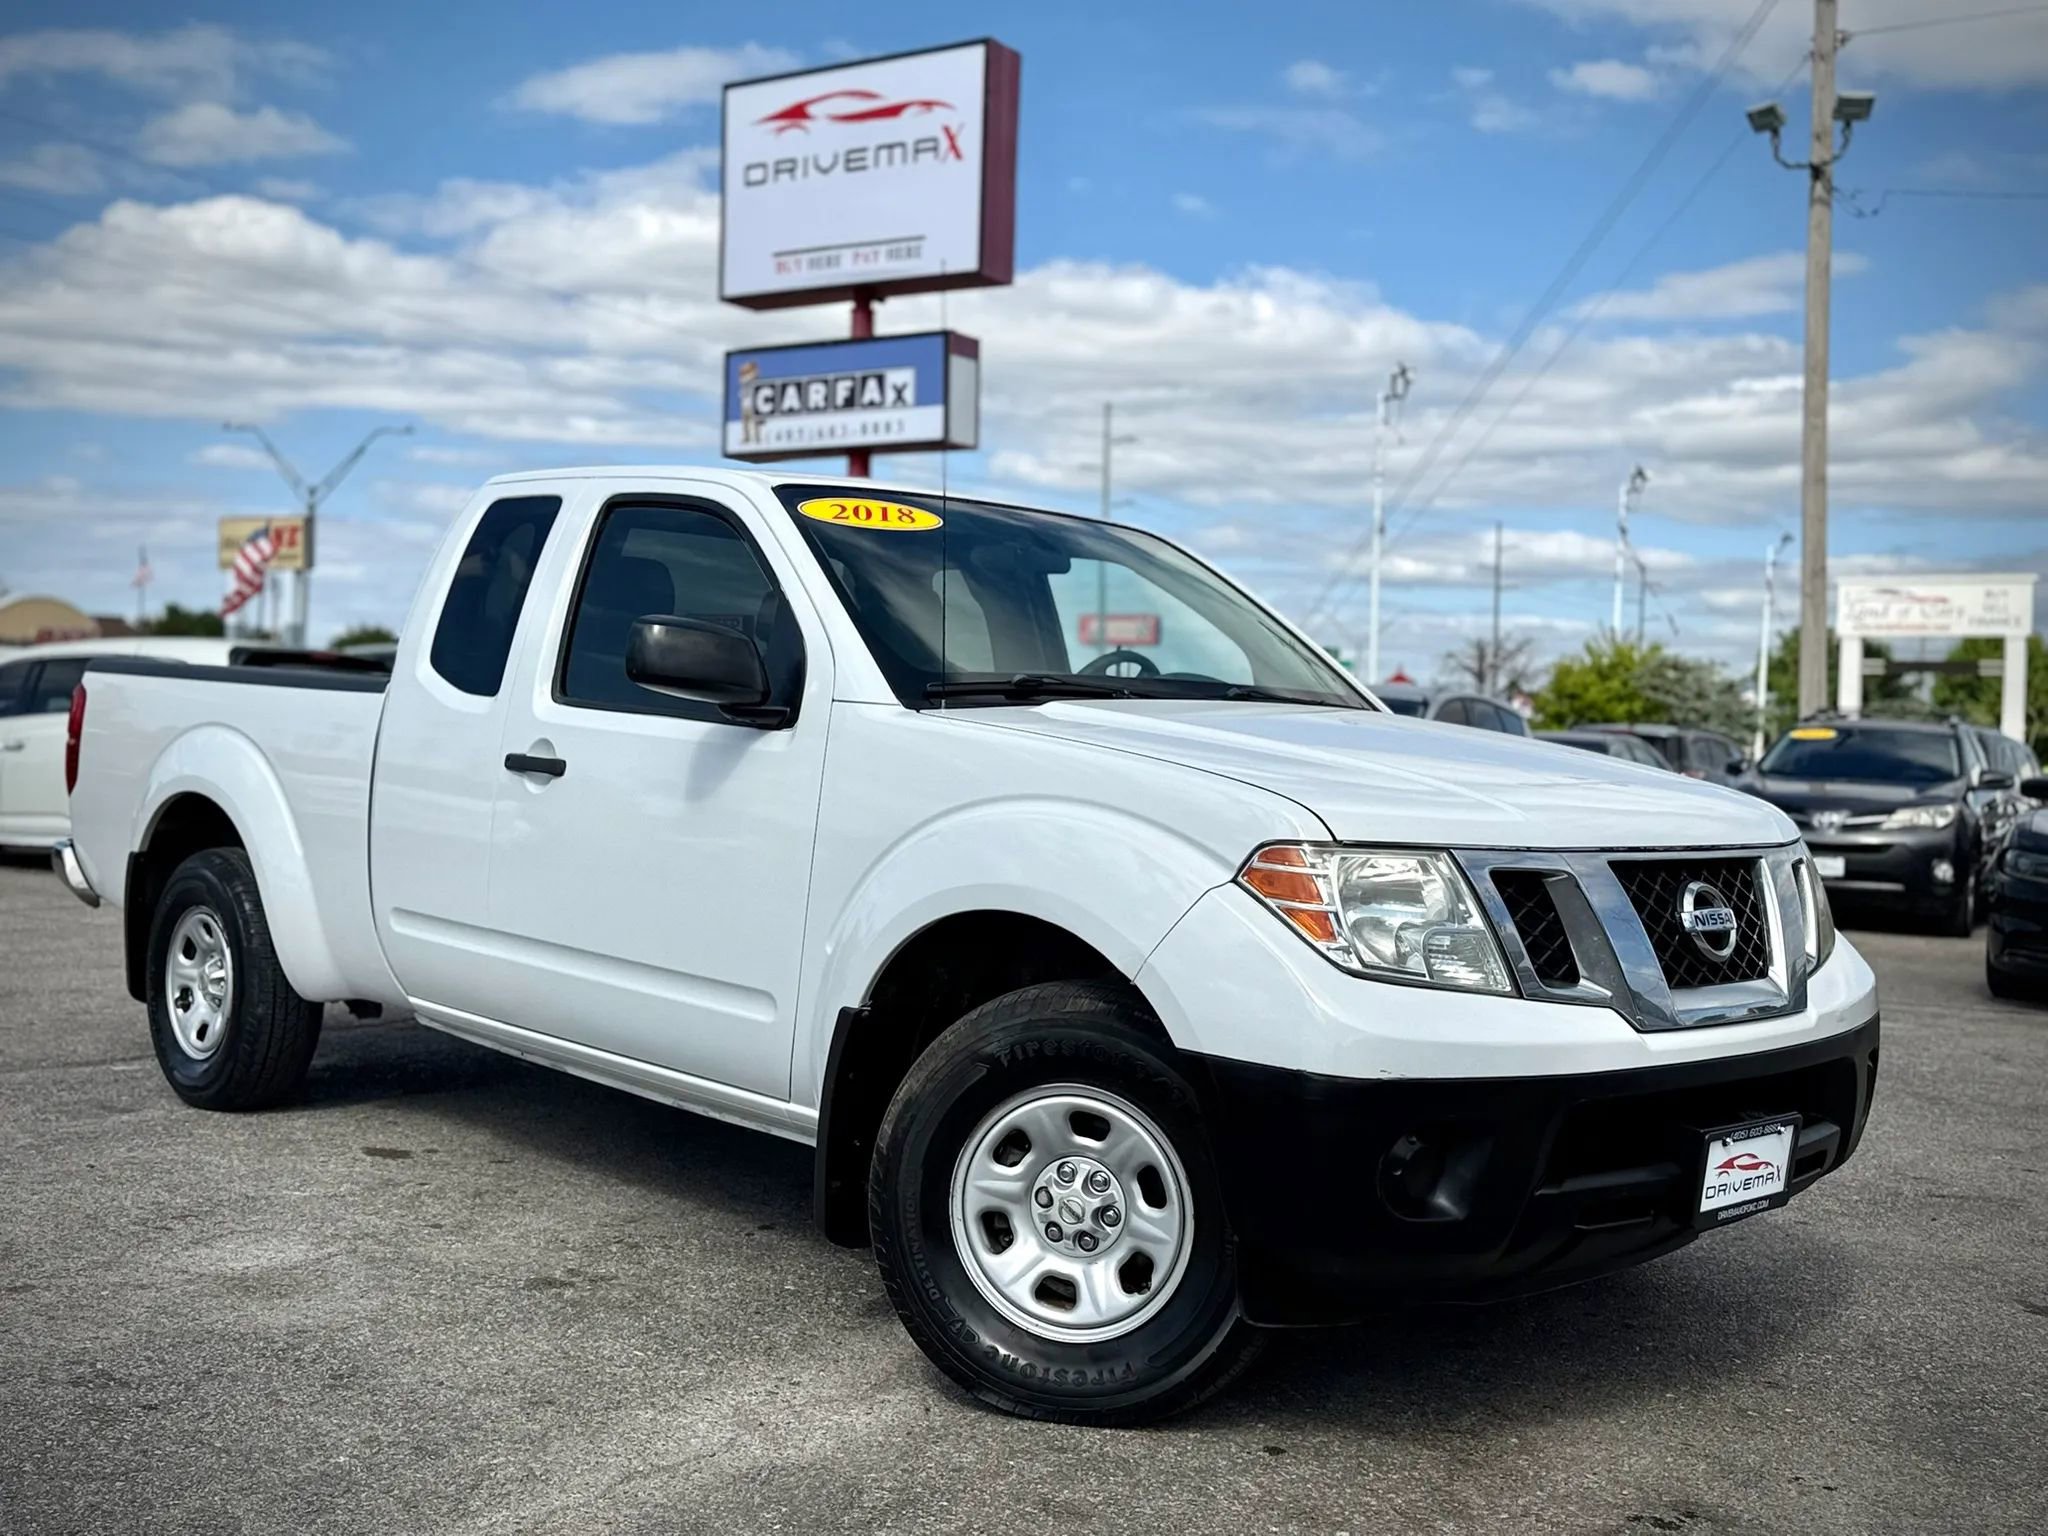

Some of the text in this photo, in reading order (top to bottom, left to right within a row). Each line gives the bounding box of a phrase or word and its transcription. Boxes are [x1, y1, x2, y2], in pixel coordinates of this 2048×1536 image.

[744, 122, 963, 187] DRIVEMAX
[755, 376, 908, 415] CARFAX
[829, 504, 916, 524] 2018
[1705, 1164, 1782, 1199] DRIVEMAX
